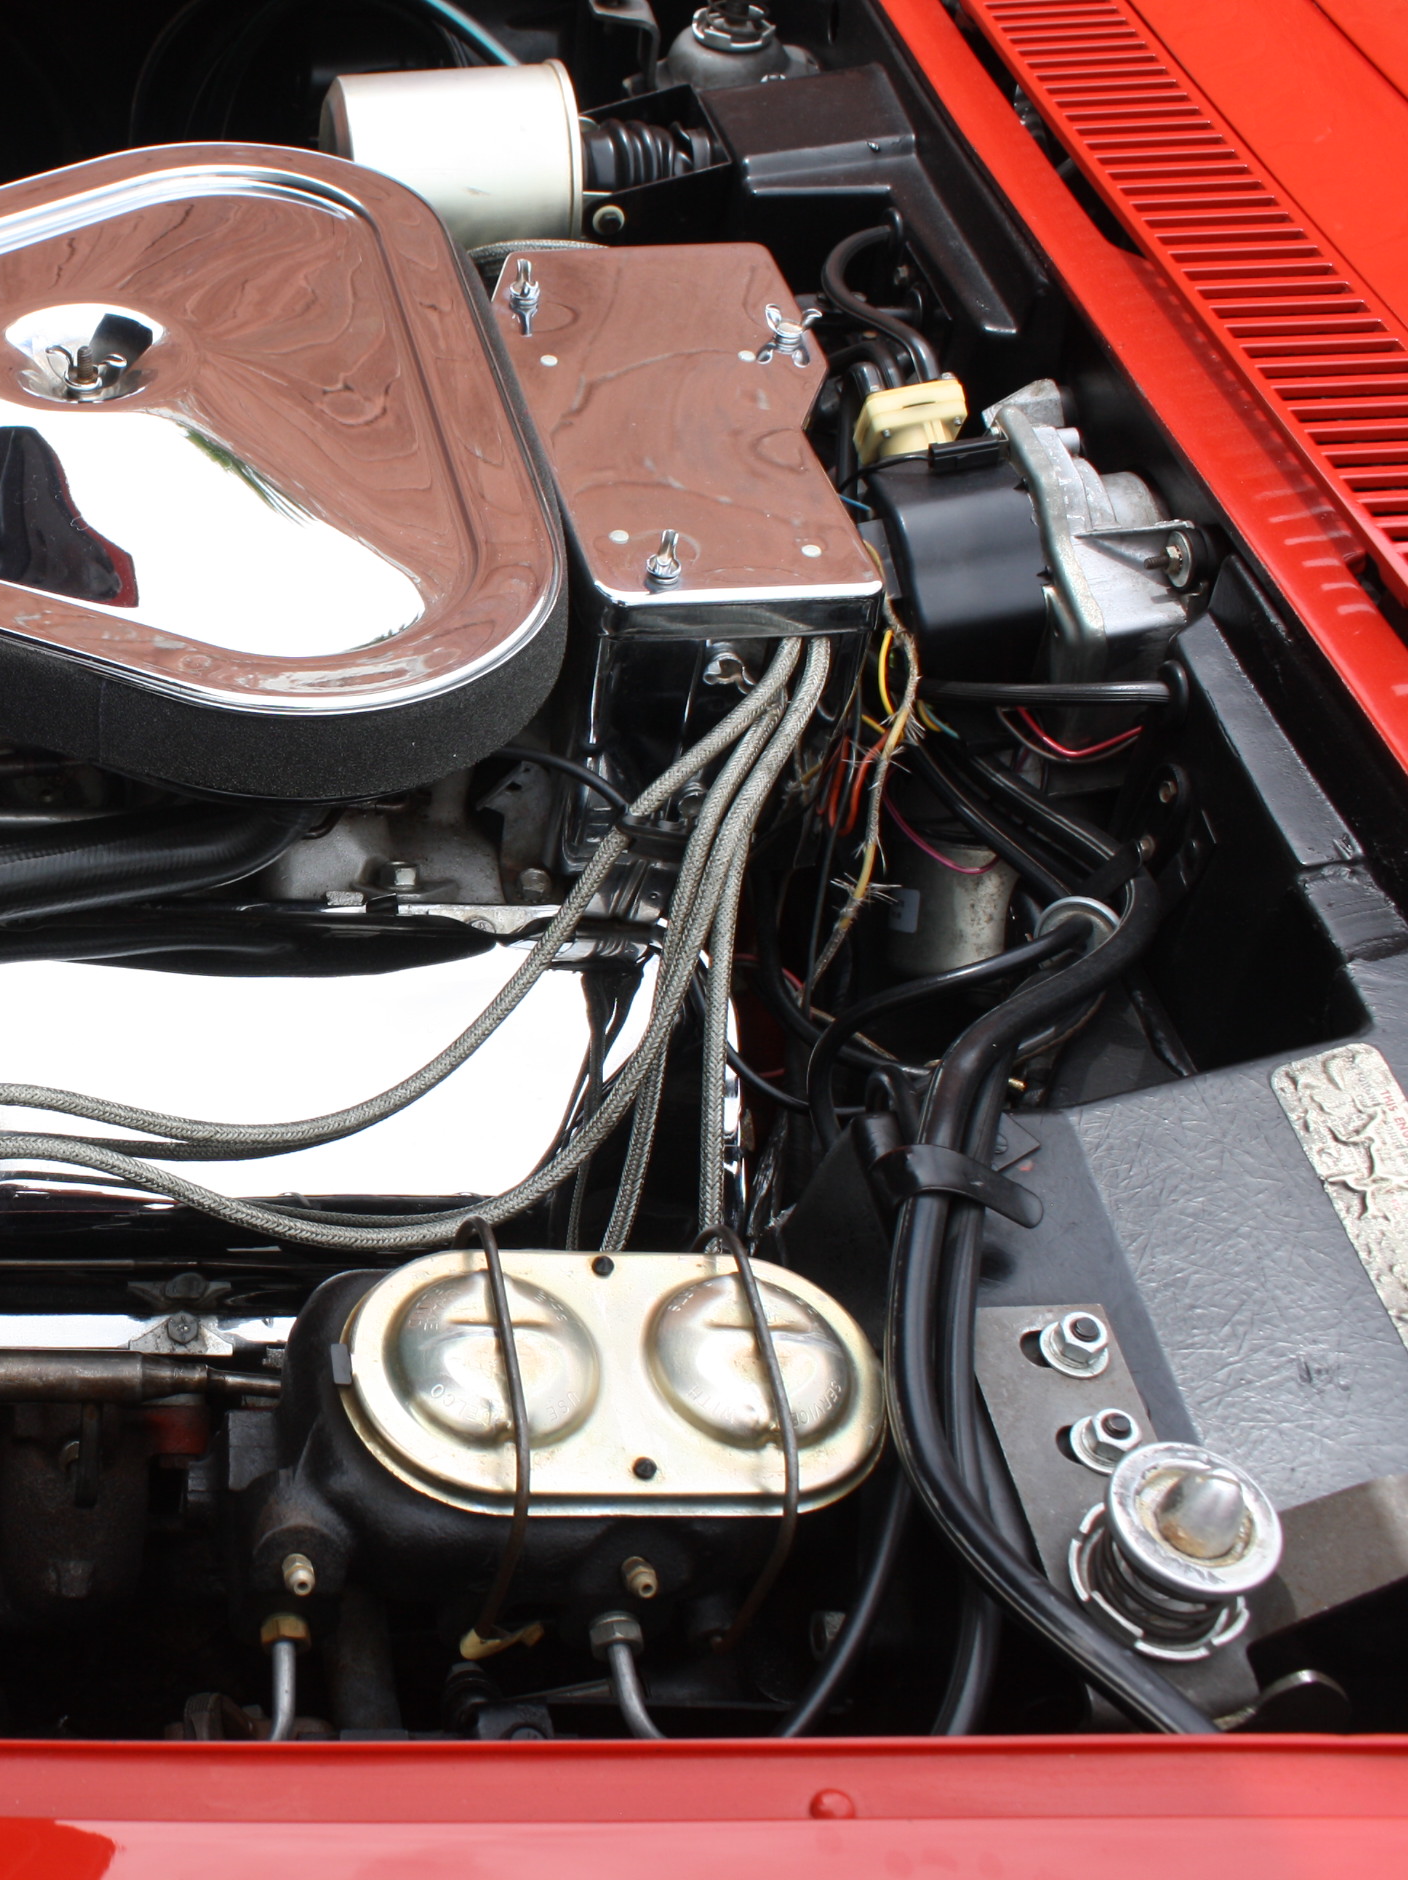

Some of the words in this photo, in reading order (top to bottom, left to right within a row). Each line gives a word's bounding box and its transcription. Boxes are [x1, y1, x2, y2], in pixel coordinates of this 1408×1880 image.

[1380, 1090, 1399, 1112] THIS
[546, 1390, 581, 1421] USE
[687, 1383, 737, 1425] WITH
[790, 1380, 843, 1430] SERVICE
